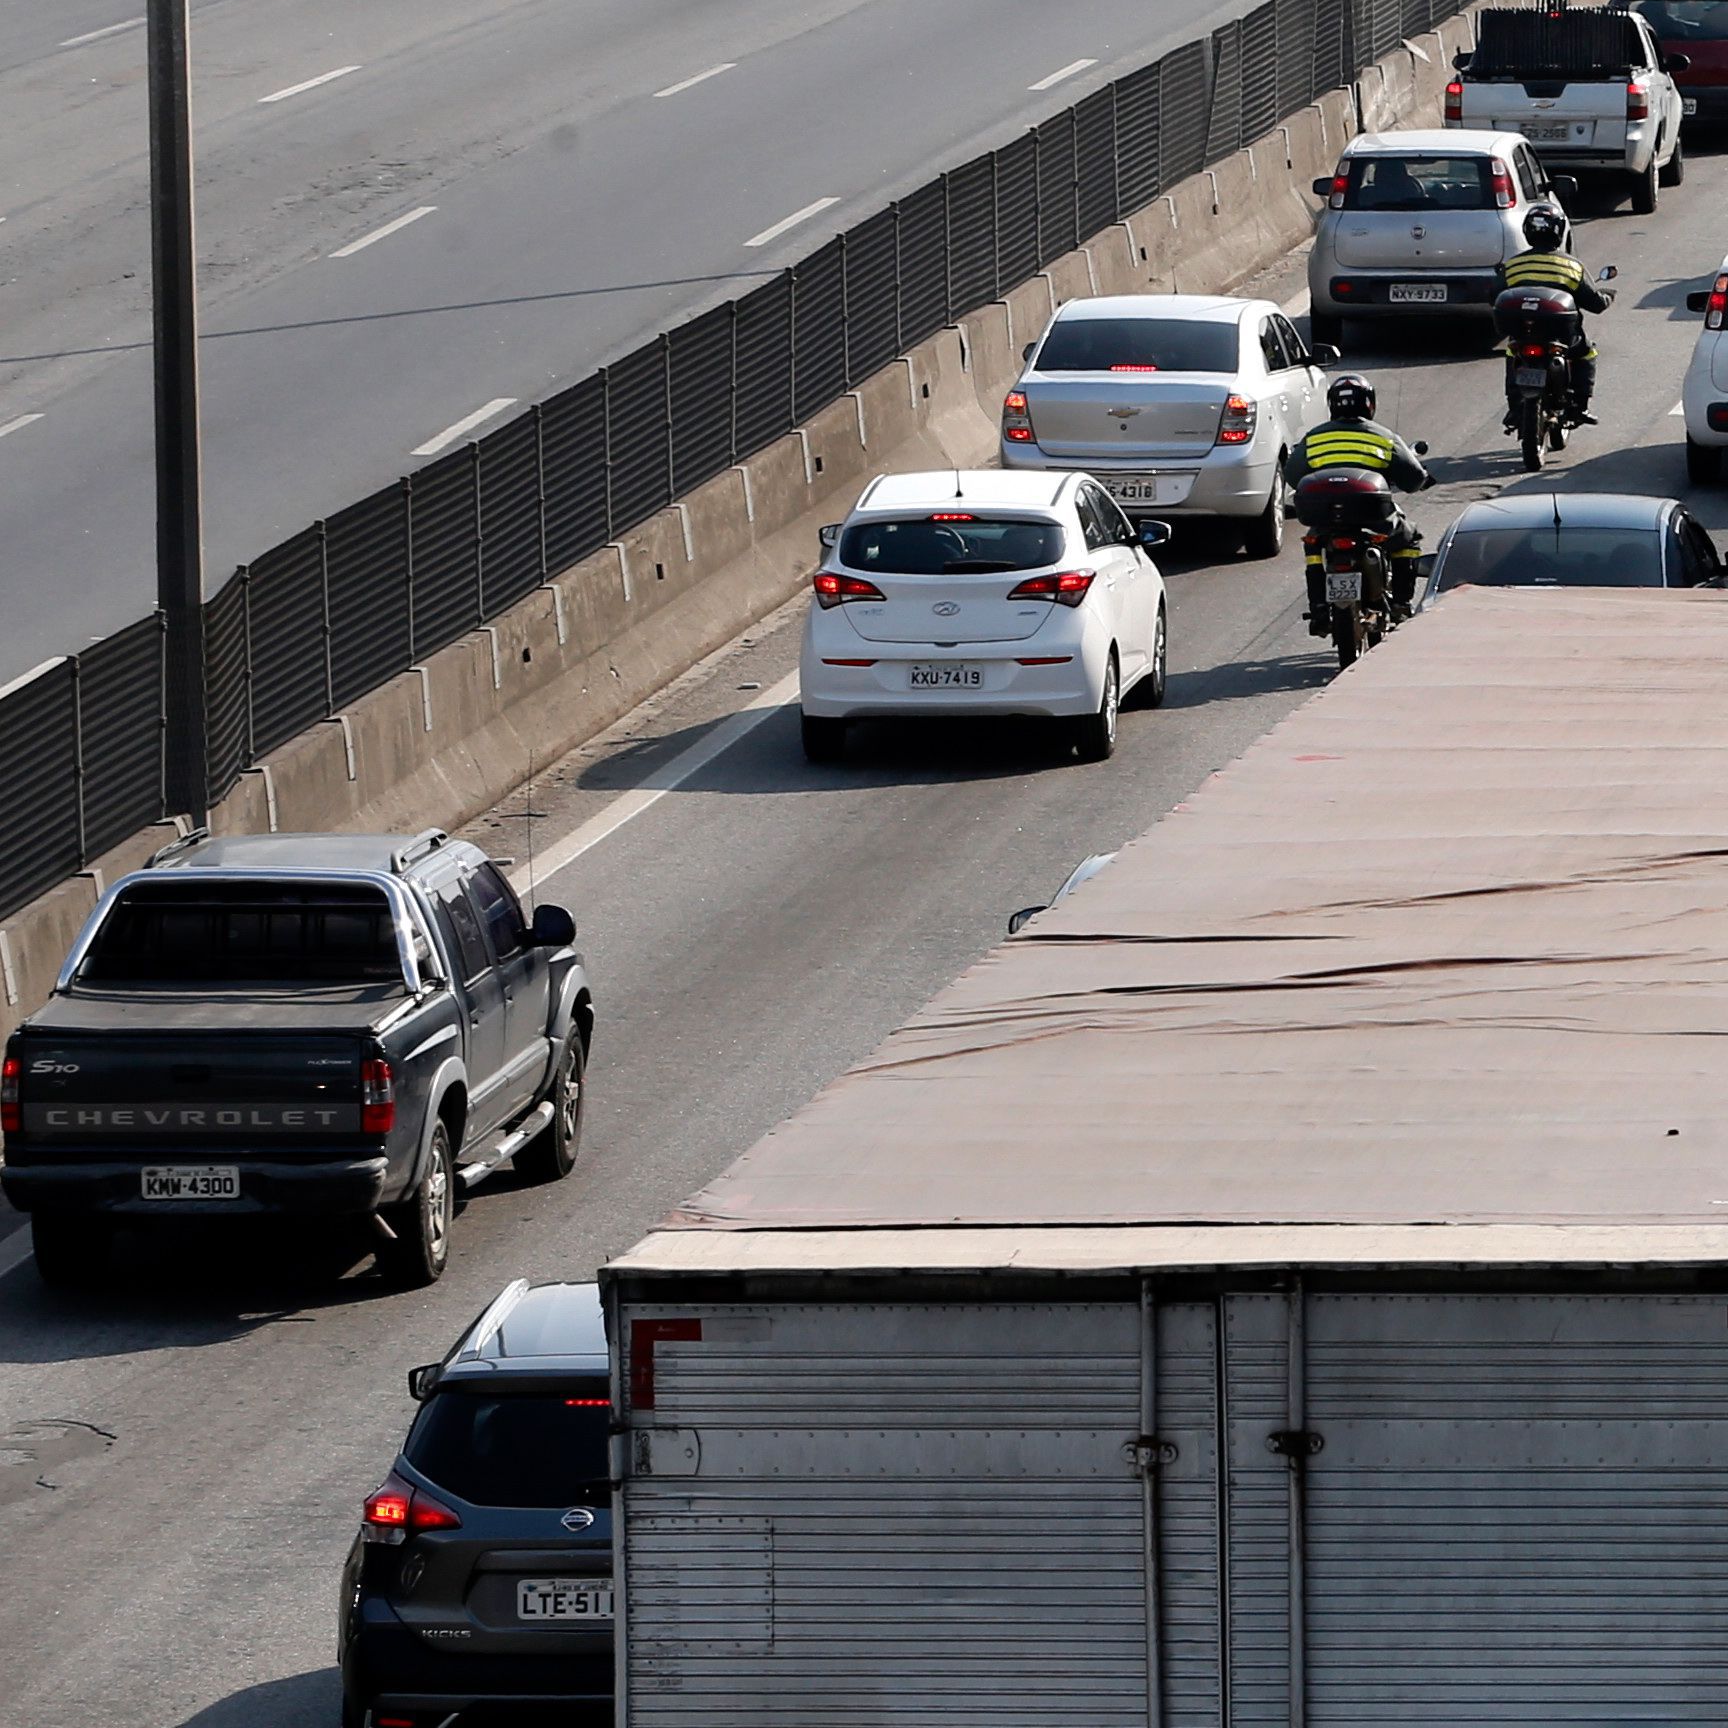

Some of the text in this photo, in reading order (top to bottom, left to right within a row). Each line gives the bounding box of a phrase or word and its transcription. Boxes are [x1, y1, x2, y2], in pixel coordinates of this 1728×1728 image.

[30, 1060, 80, 1073] S10
[46, 1110, 338, 1125] CHEVROLET
[422, 1629, 472, 1638] KICKS
